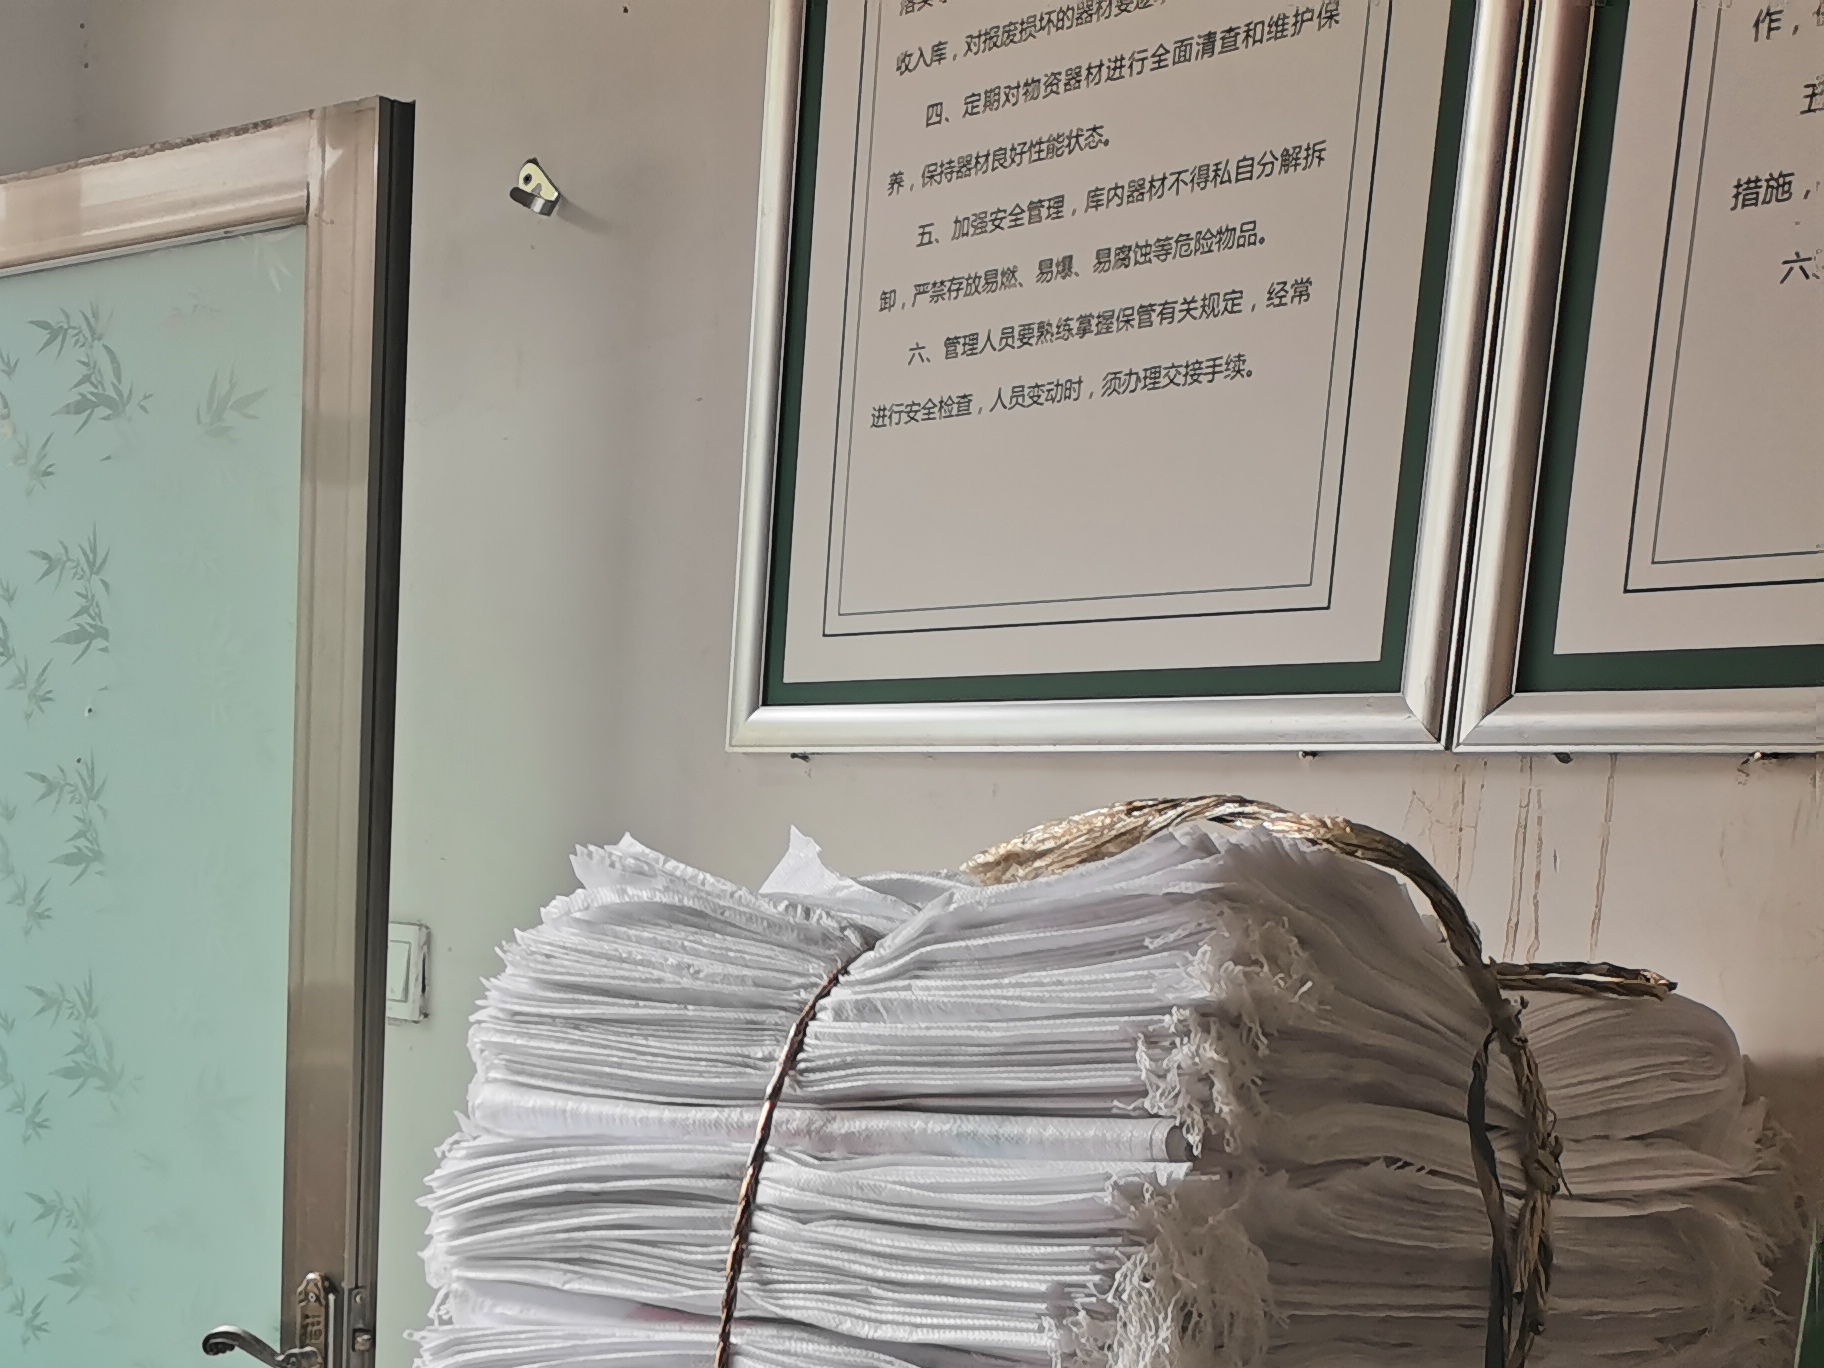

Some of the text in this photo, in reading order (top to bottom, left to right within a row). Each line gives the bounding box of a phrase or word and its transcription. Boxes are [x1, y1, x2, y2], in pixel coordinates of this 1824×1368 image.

[887, 124, 1109, 196] 养，保持器材良好性能状态。
[916, 139, 1327, 247] 五、加强安全管理，库内器材不得私自分解拆
[908, 277, 1312, 366] 六、管理人员要熟练掌握保管有关规定，经常
[870, 352, 1252, 428] 进行安全检查，人员变动时，须办理交接手续。
